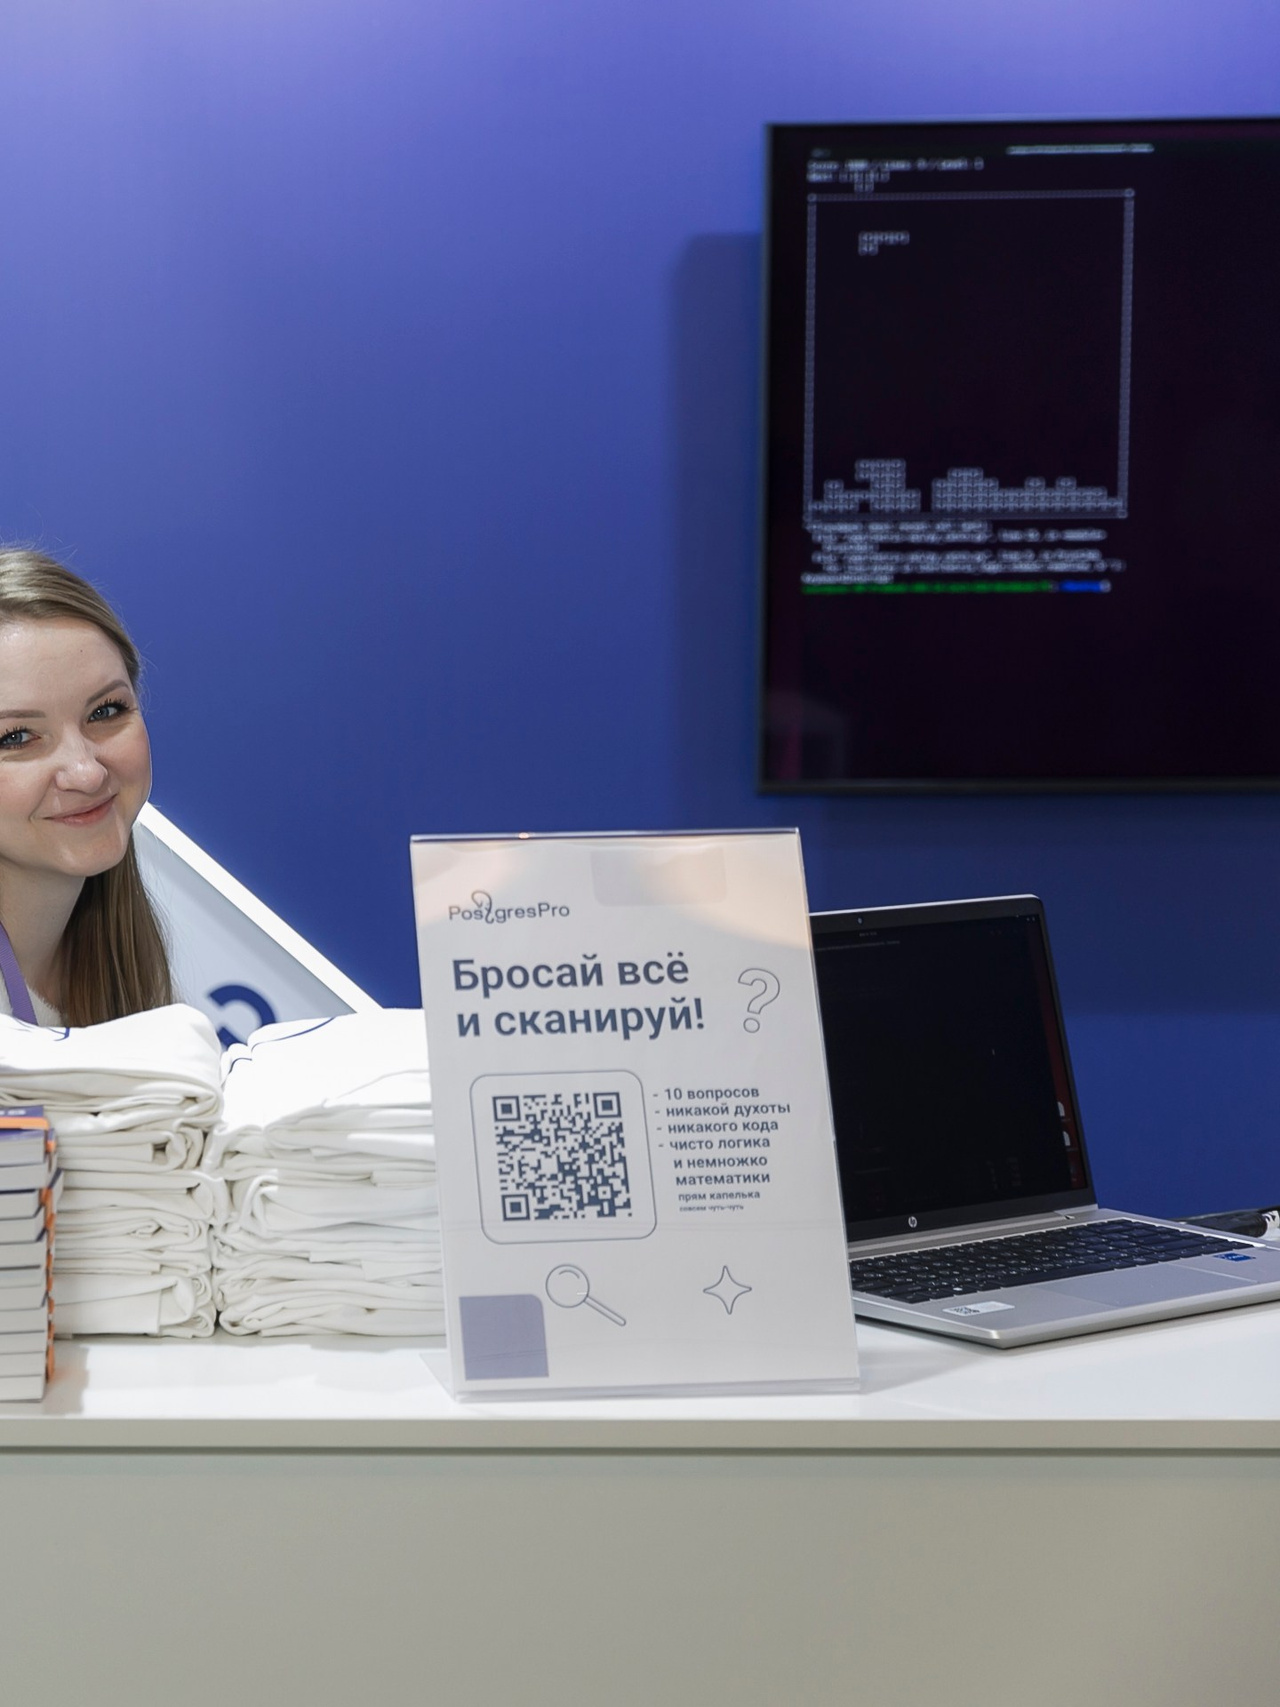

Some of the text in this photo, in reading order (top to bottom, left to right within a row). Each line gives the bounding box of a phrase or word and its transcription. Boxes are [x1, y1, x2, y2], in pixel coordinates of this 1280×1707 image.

[452, 951, 689, 999] Бросай всё
[457, 997, 705, 1041] и сканируй!
[664, 1088, 683, 1100] 10
[687, 1088, 760, 1102] вопросов
[666, 1102, 729, 1117] никакой
[734, 1103, 791, 1118] духоты
[668, 1122, 738, 1134] никакого
[742, 1120, 779, 1133] кода
[669, 1139, 714, 1151] чисто
[718, 1137, 770, 1149] логика
[673, 1156, 768, 1169] и немножко
[675, 1172, 771, 1186] математики
[678, 1190, 761, 1203] прям капелька
